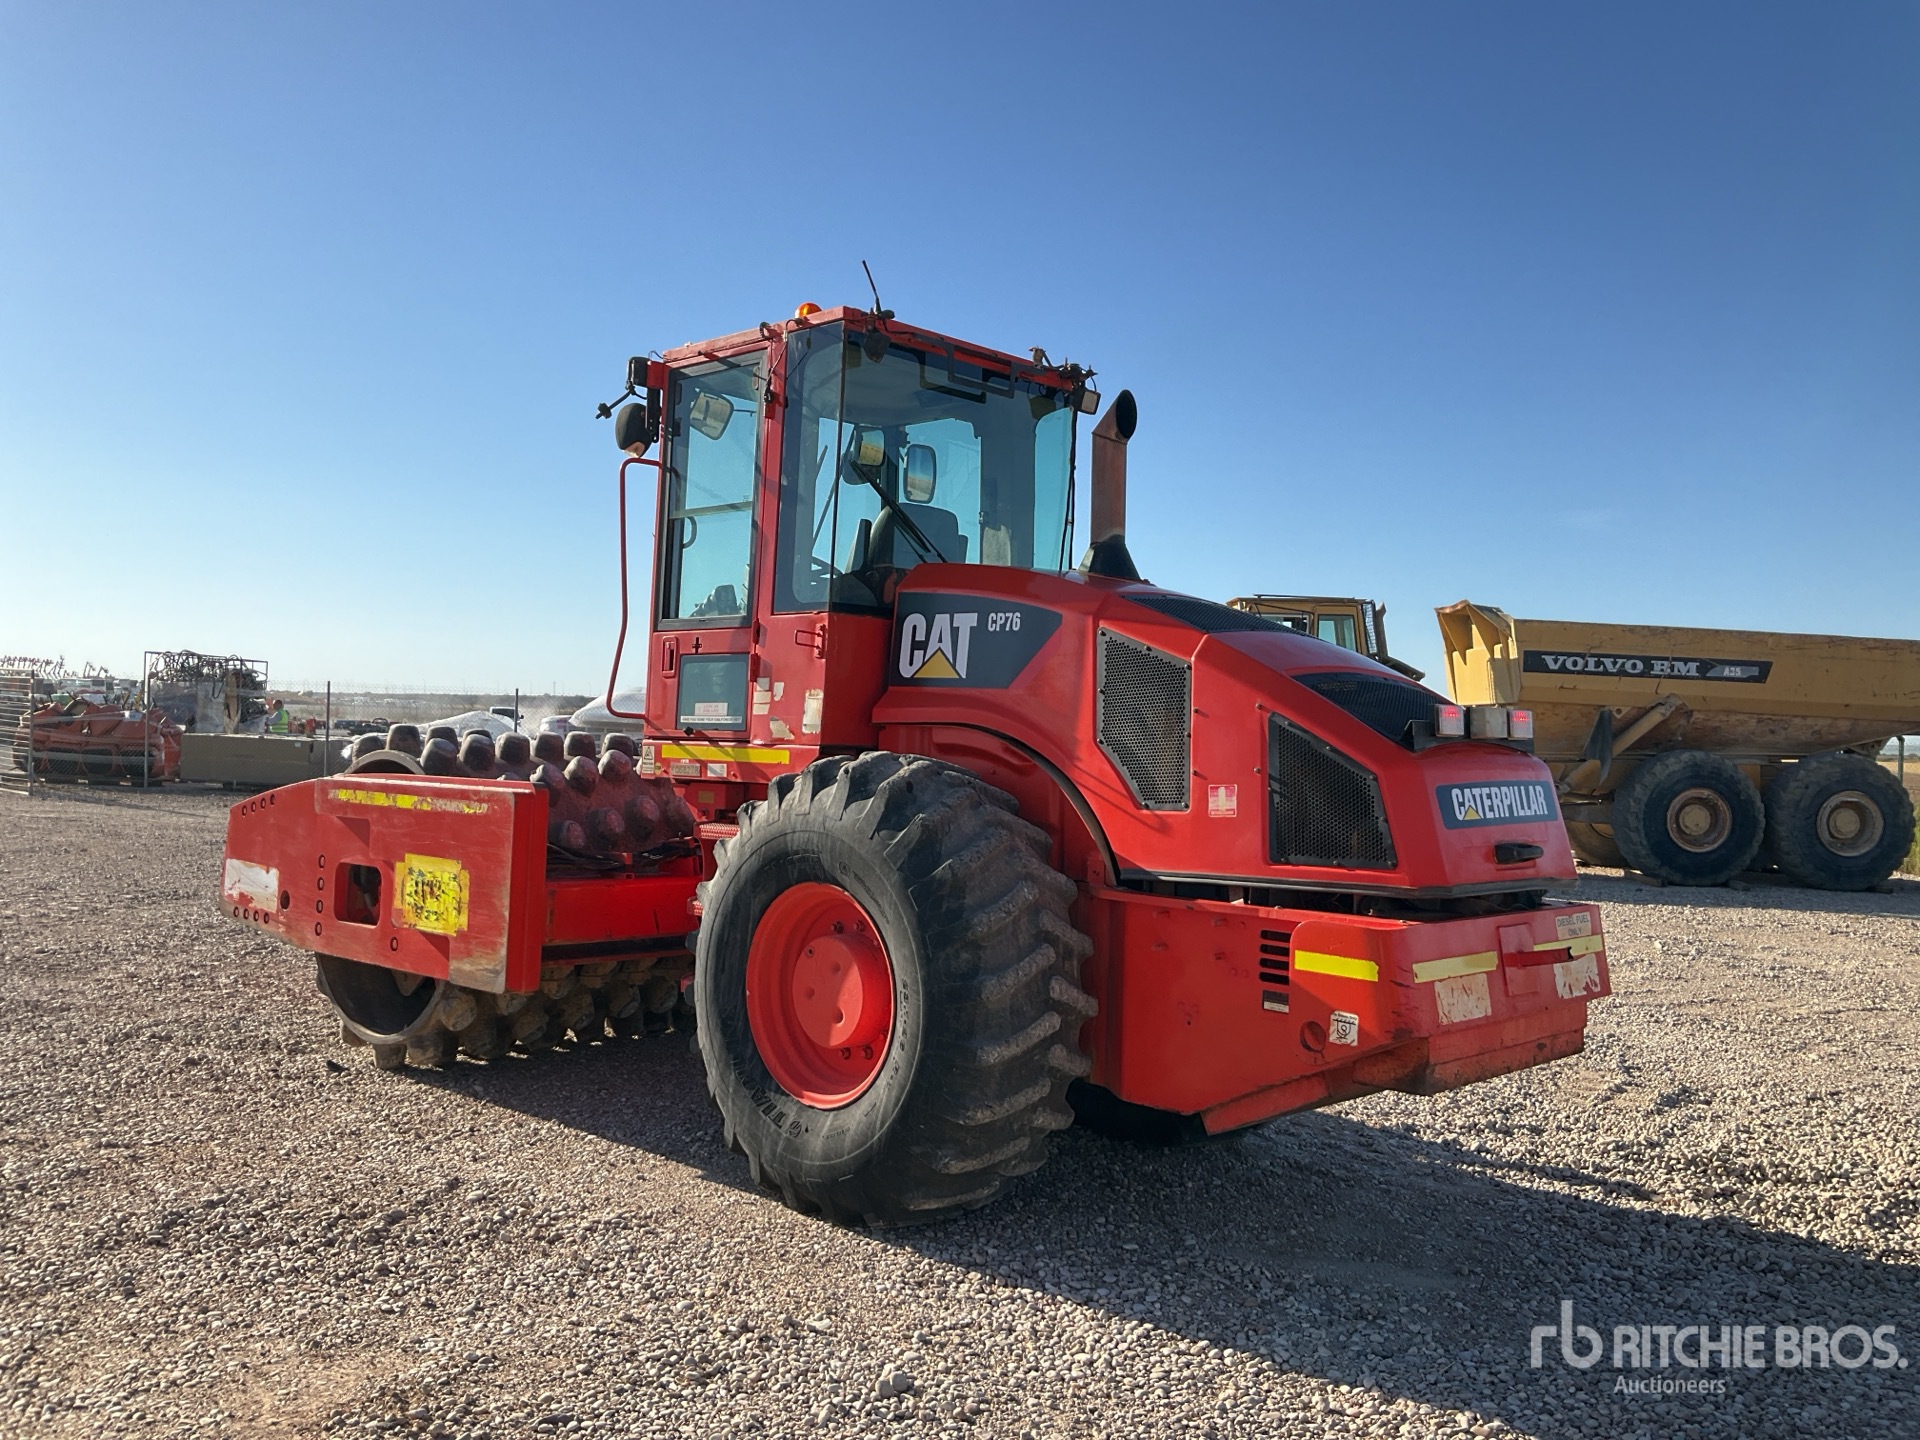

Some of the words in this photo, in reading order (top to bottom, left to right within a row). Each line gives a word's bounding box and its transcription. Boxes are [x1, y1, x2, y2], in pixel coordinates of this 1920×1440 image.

[899, 612, 978, 679] CAT
[988, 612, 1021, 631] CP76
[1541, 654, 1644, 674] VOLVO
[1650, 660, 1700, 676] BM
[1723, 666, 1742, 676] A35
[1451, 785, 1548, 820] CATERPILLAR
[1557, 916, 1575, 927] DIESEL
[1576, 915, 1589, 924] FUEL
